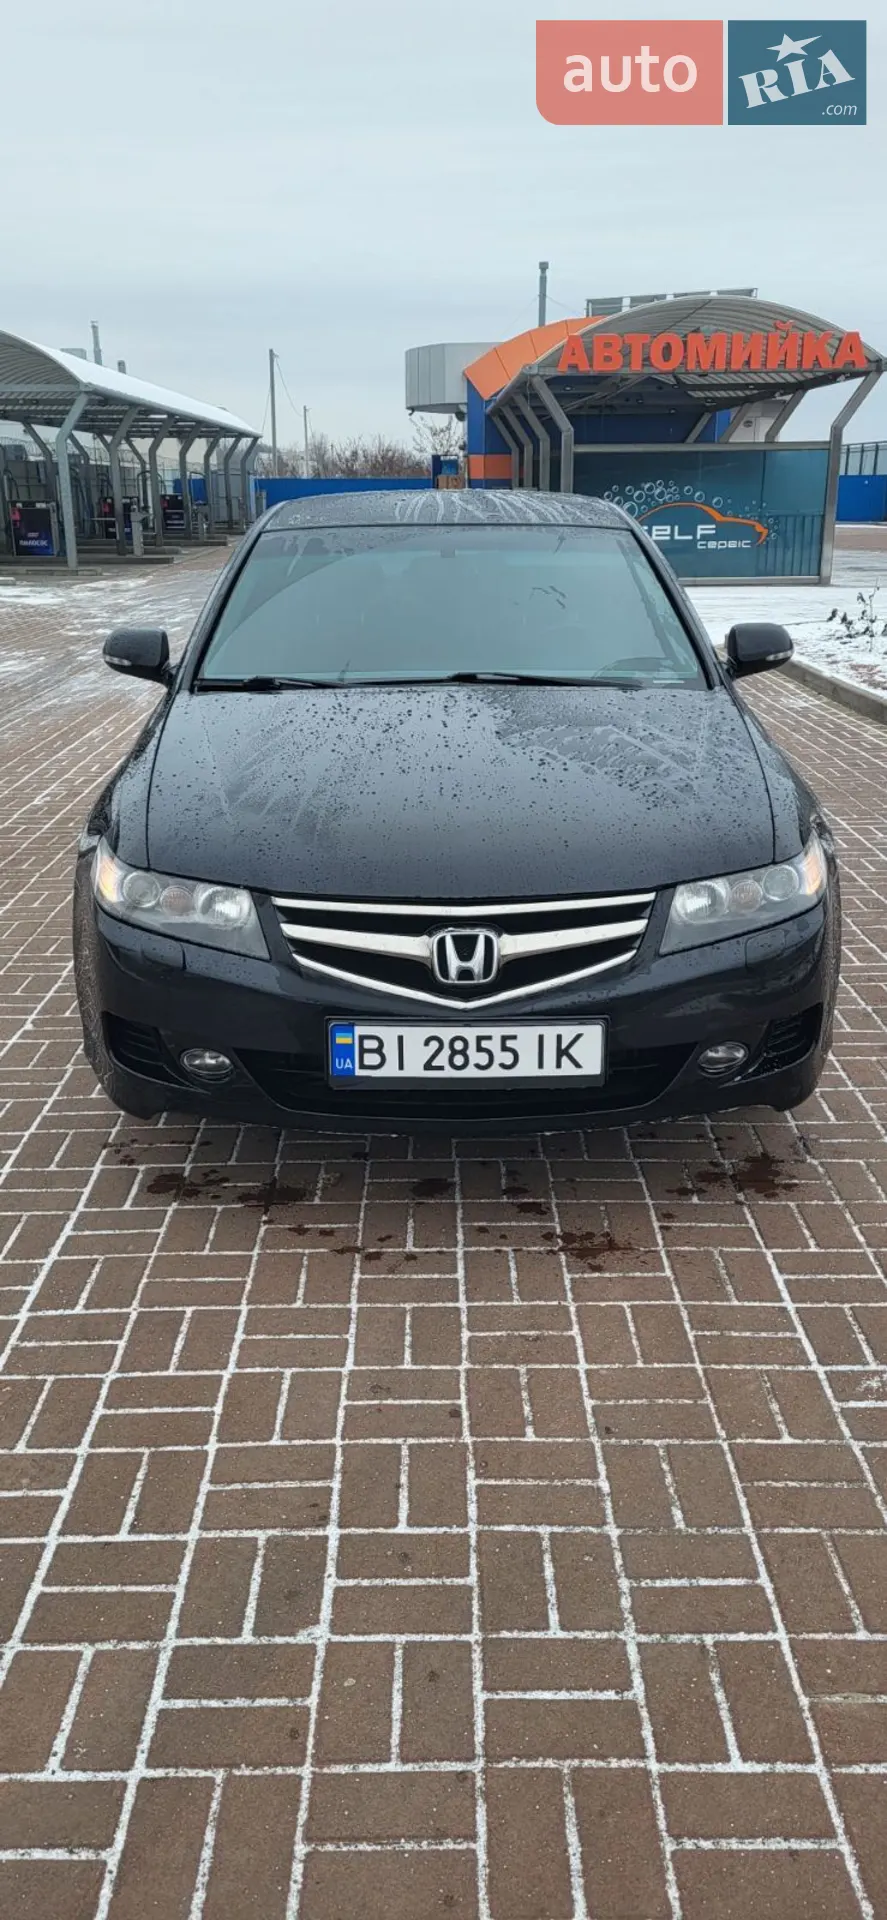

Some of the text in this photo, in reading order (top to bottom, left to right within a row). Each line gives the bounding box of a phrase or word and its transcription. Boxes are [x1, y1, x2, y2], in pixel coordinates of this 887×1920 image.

[557, 320, 867, 372] АВТОМИЙКА
[641, 524, 716, 540] ELF
[335, 1057, 354, 1070] UA
[358, 1033, 584, 1071] BI 2855 IK
